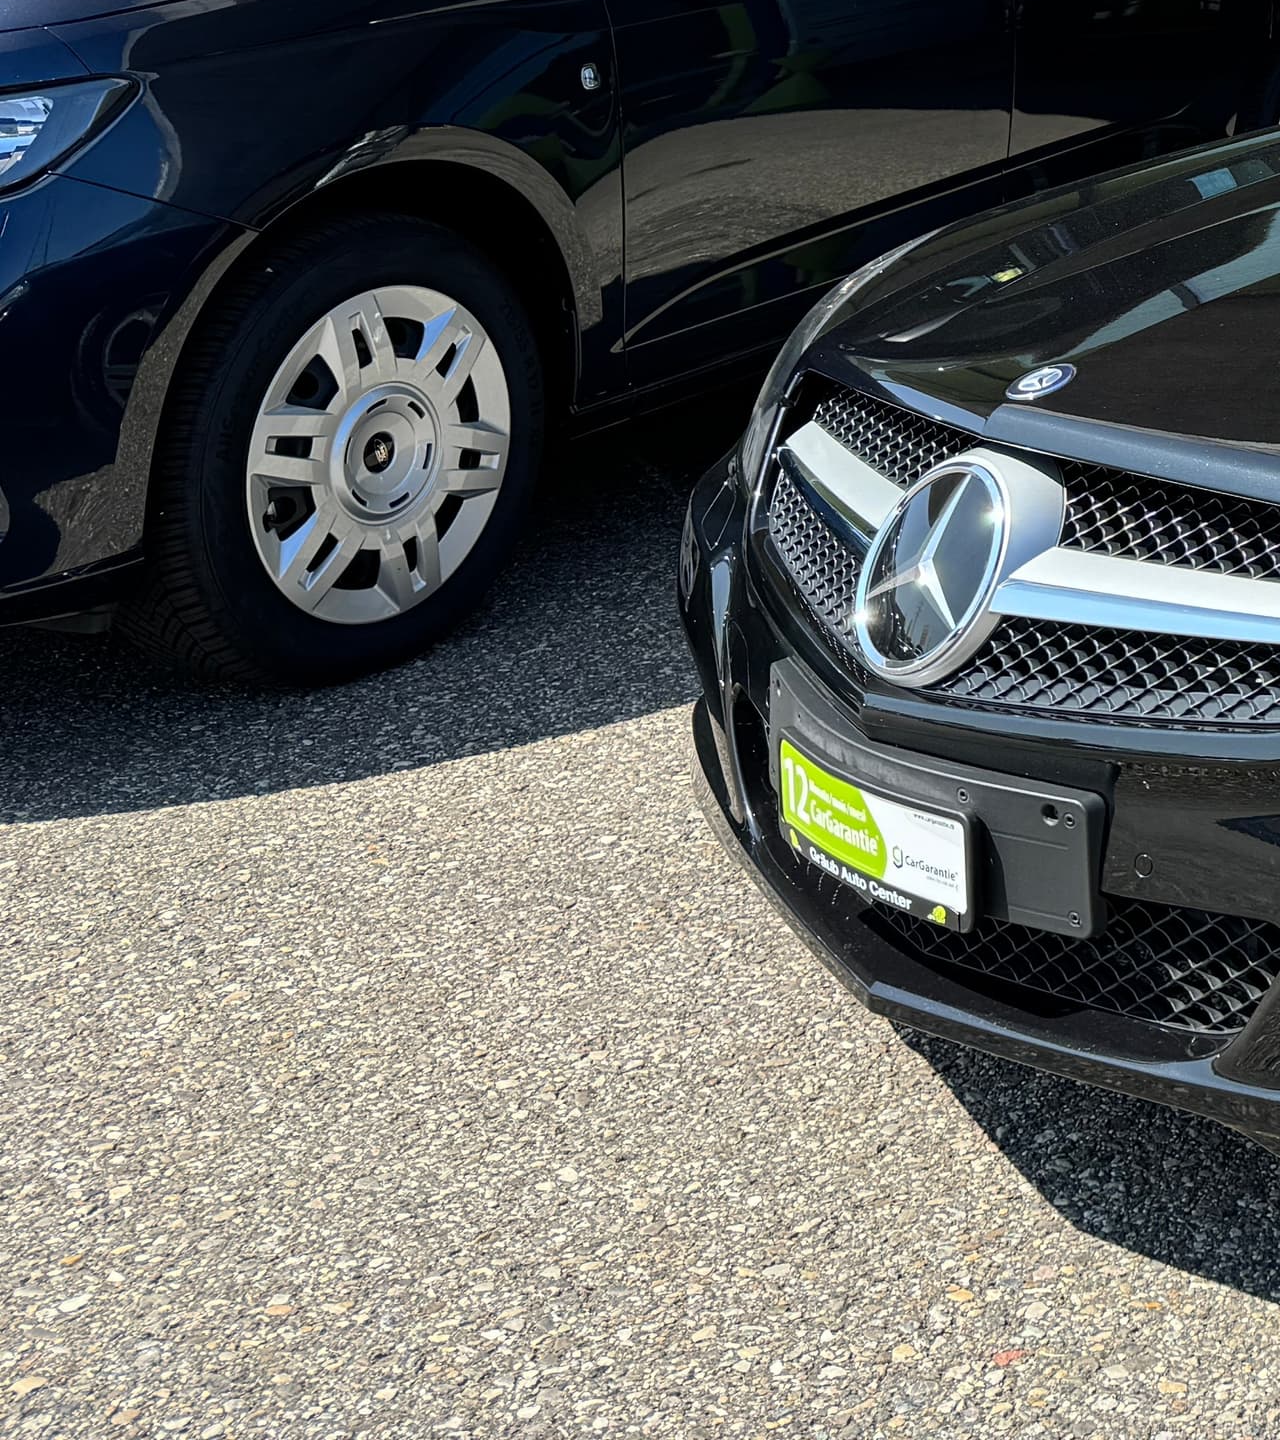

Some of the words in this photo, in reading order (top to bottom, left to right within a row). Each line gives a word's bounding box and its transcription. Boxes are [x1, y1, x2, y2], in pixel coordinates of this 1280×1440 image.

[783, 758, 810, 825] 12
[810, 799, 878, 856] CarGarantie
[809, 846, 840, 876] Gräub
[840, 866, 867, 891] Auto
[868, 880, 913, 911] Center
[905, 855, 956, 881] CarGarantie
